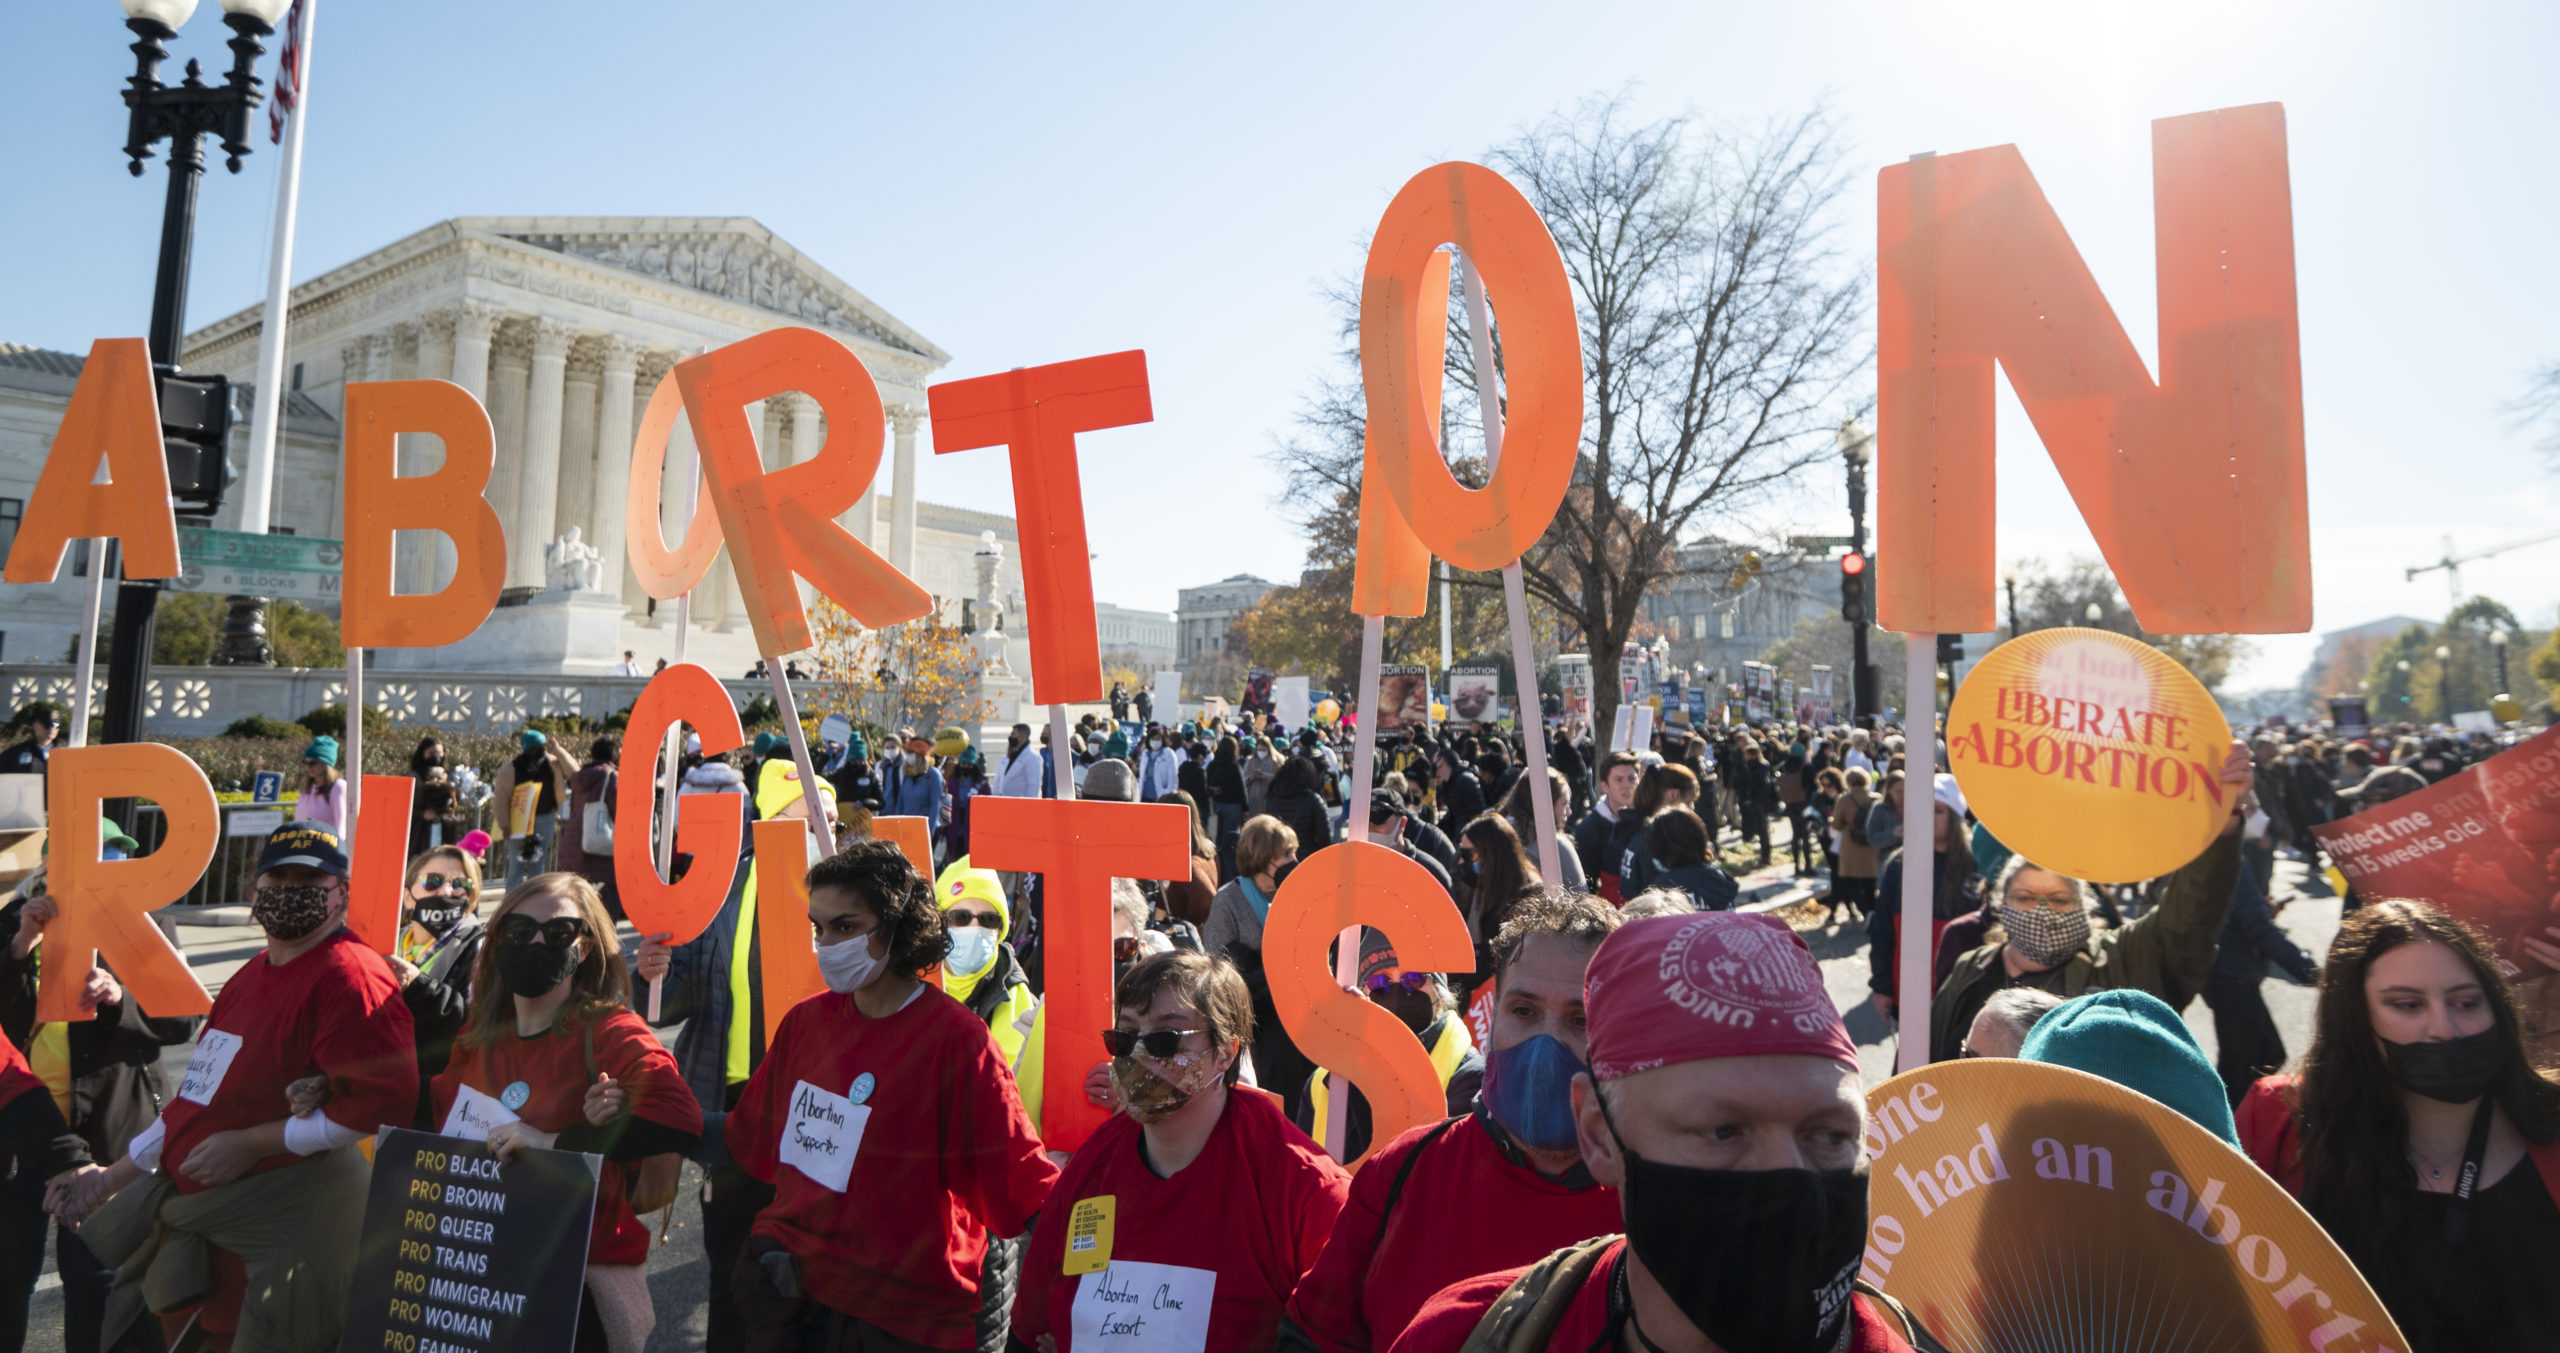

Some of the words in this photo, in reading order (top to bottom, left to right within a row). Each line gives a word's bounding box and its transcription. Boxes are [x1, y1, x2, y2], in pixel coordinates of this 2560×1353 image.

[227, 542, 237, 553] 3
[242, 544, 299, 557] BLOCKS
[223, 575, 232, 585] 6
[240, 576, 297, 589] BLOCKS
[319, 574, 339, 592] M
[1379, 665, 1425, 676] BORTION
[1450, 666, 1498, 675] ABORTION
[1996, 687, 2189, 752] LIBERATE
[1951, 721, 2223, 808] ABORTION
[270, 829, 338, 848] ABORTION
[290, 840, 312, 849] AF
[2317, 822, 2394, 858] Protect
[2389, 810, 2433, 837] me
[2355, 852, 2380, 875] 15
[2376, 832, 2446, 868] weeks
[2444, 816, 2486, 845] old
[421, 905, 462, 922] VOTE
[1663, 979, 1755, 1030] UNION
[795, 1086, 845, 1130] Abortion
[1866, 1081, 1945, 1162] one
[795, 1121, 839, 1156] Supporter
[415, 1149, 447, 1173] PRO
[449, 1154, 502, 1181] BLACK
[2457, 1161, 2478, 1199] Canon
[410, 1179, 442, 1202] PRO
[444, 1184, 506, 1214] BROWN
[405, 1209, 436, 1232] PRO
[440, 1215, 495, 1243] QUEER
[1893, 1122, 2011, 1219] had
[2031, 1137, 2115, 1191] an
[2146, 1177, 2398, 1353] abort
[399, 1239, 431, 1263] PRO
[435, 1246, 489, 1275] TRANS
[394, 1269, 426, 1294] PRO
[428, 1277, 527, 1317] IMMIGRANT
[1093, 1268, 1139, 1305] Abortion
[389, 1298, 421, 1322] PRO
[425, 1306, 492, 1341] WOMAN
[1100, 1311, 1147, 1337] Escort
[384, 1329, 416, 1353] PRO
